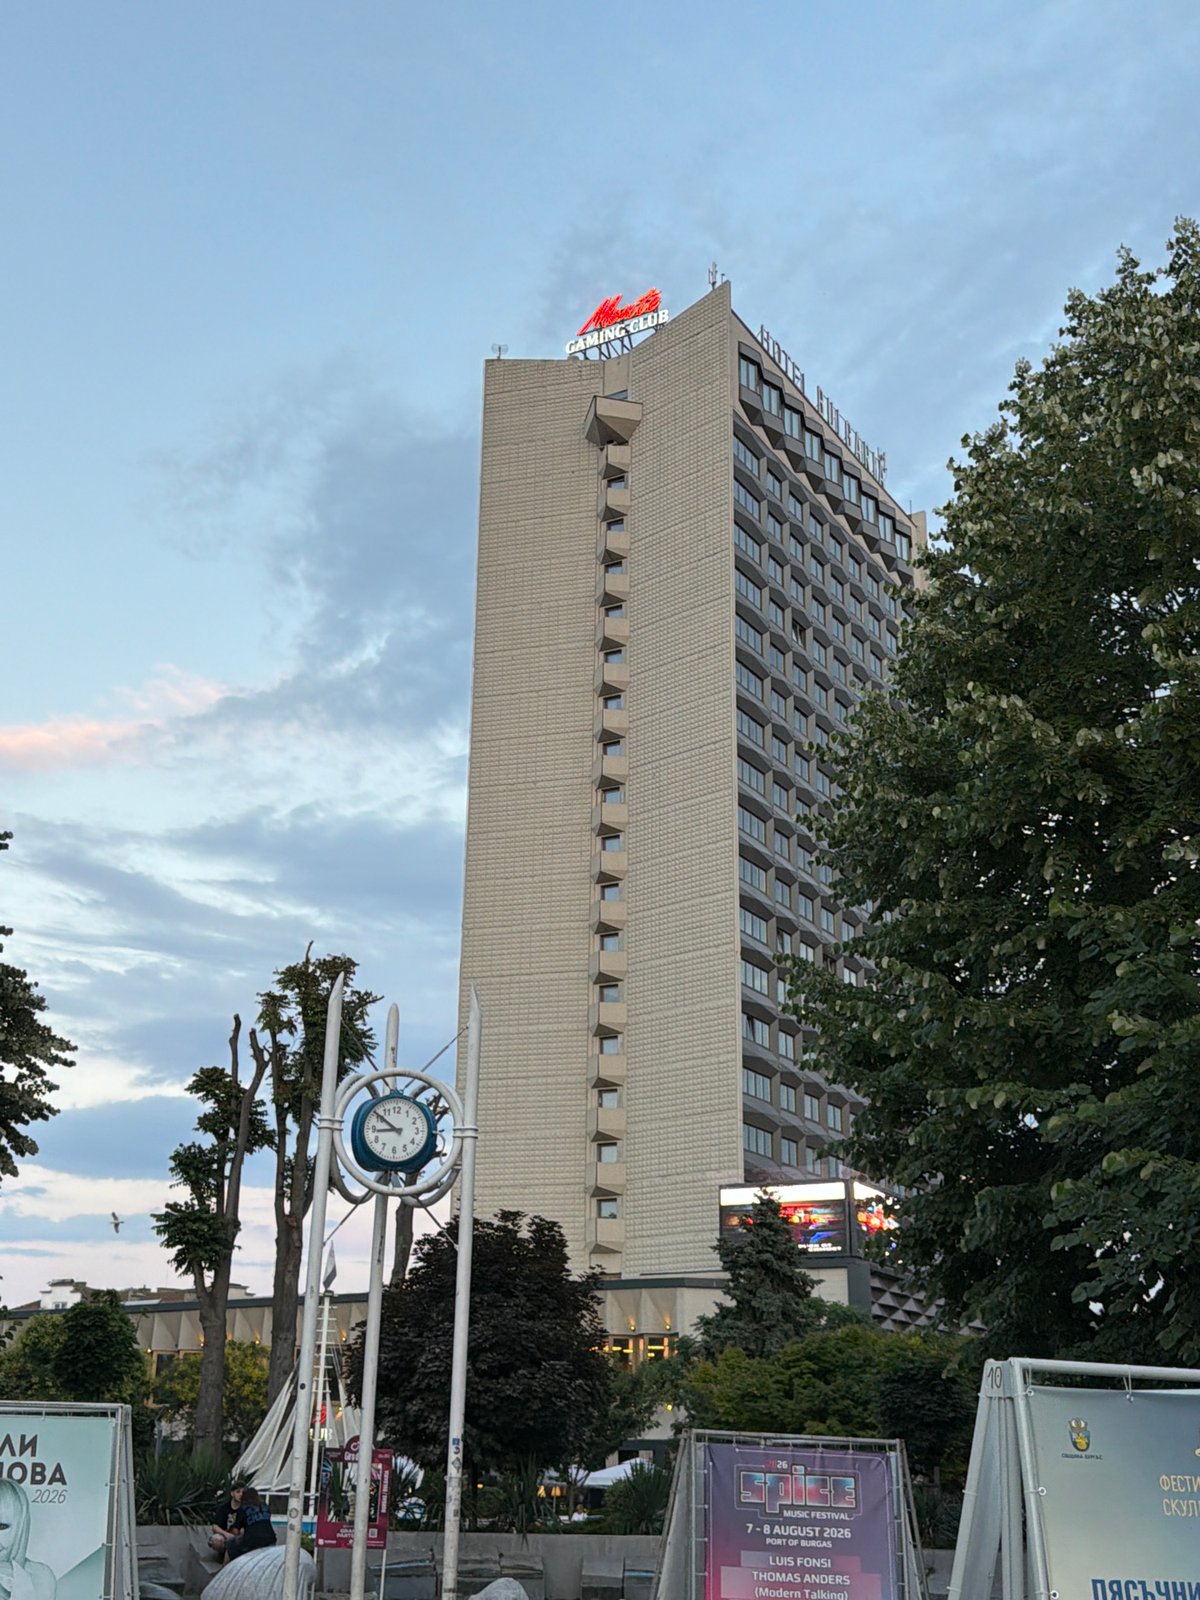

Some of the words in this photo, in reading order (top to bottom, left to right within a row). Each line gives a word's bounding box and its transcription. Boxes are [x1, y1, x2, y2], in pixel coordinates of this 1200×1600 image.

[565, 323, 626, 354] GAMING
[629, 309, 669, 335] CLUB
[383, 1108, 391, 1117] 11
[392, 1106, 402, 1115] 12
[405, 1110, 409, 1118] 1
[412, 1117, 417, 1125] 2
[371, 1125, 377, 1133] 9
[414, 1127, 420, 1136] 3
[374, 1136, 379, 1144] 8
[381, 1143, 386, 1151] 7
[391, 1146, 397, 1155] 6
[402, 1144, 408, 1152] 5
[987, 1366, 1003, 1390] 10
[32, 1489, 68, 1504] 2026
[1163, 1499, 1200, 1517] СКУЛ
[783, 1509, 809, 1519] MUSIC
[811, 1511, 850, 1520] FESTIVAL
[746, 1523, 753, 1534] 7
[763, 1524, 771, 1535] 8
[773, 1525, 821, 1537] AUGUST
[823, 1527, 852, 1539] 2026
[766, 1538, 786, 1546] PORT
[800, 1540, 832, 1548] BURGAS
[769, 1556, 794, 1567] LUIS
[797, 1557, 832, 1568] FONSI
[752, 1571, 800, 1583] THOMAS
[803, 1573, 851, 1585] ANDERS
[755, 1586, 801, 1599] (Modern
[804, 1589, 849, 1600] Talking)
